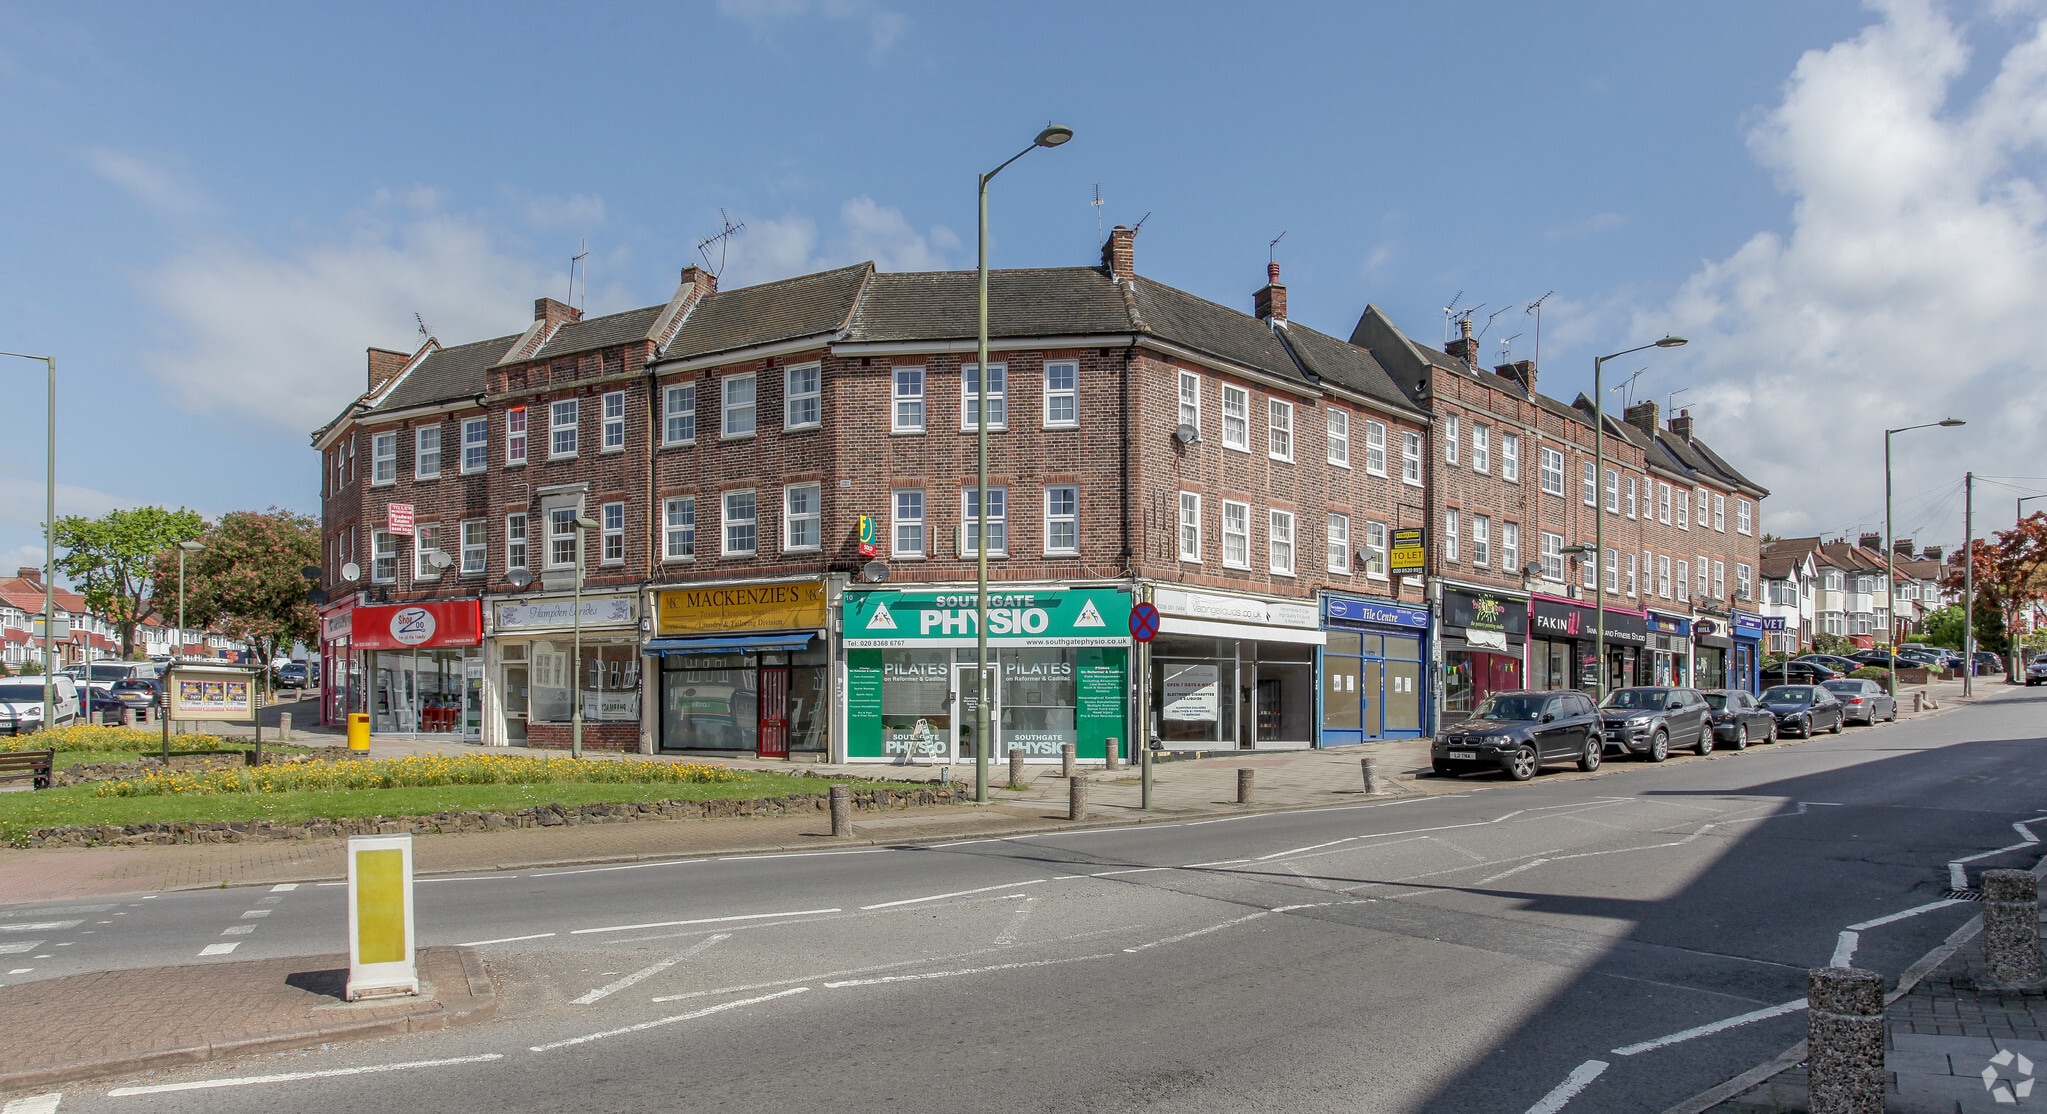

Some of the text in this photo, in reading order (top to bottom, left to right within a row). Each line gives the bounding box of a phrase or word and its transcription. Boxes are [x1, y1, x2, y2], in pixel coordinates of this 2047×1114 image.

[687, 587, 799, 608] MACKENZIE'S
[529, 604, 567, 622] Hampden
[1363, 608, 1375, 619] Tile
[1377, 611, 1398, 622] Centre
[399, 615, 412, 625] Shoe
[920, 608, 1048, 634] PHYSIO
[1537, 611, 1580, 634] FAKIN it!
[1763, 620, 1784, 629] VET
[1026, 638, 1126, 646] www.southgatephysio.co.uk
[884, 663, 947, 675] PILATES
[1006, 663, 1071, 674] PILATES
[886, 742, 946, 754] PHYSO
